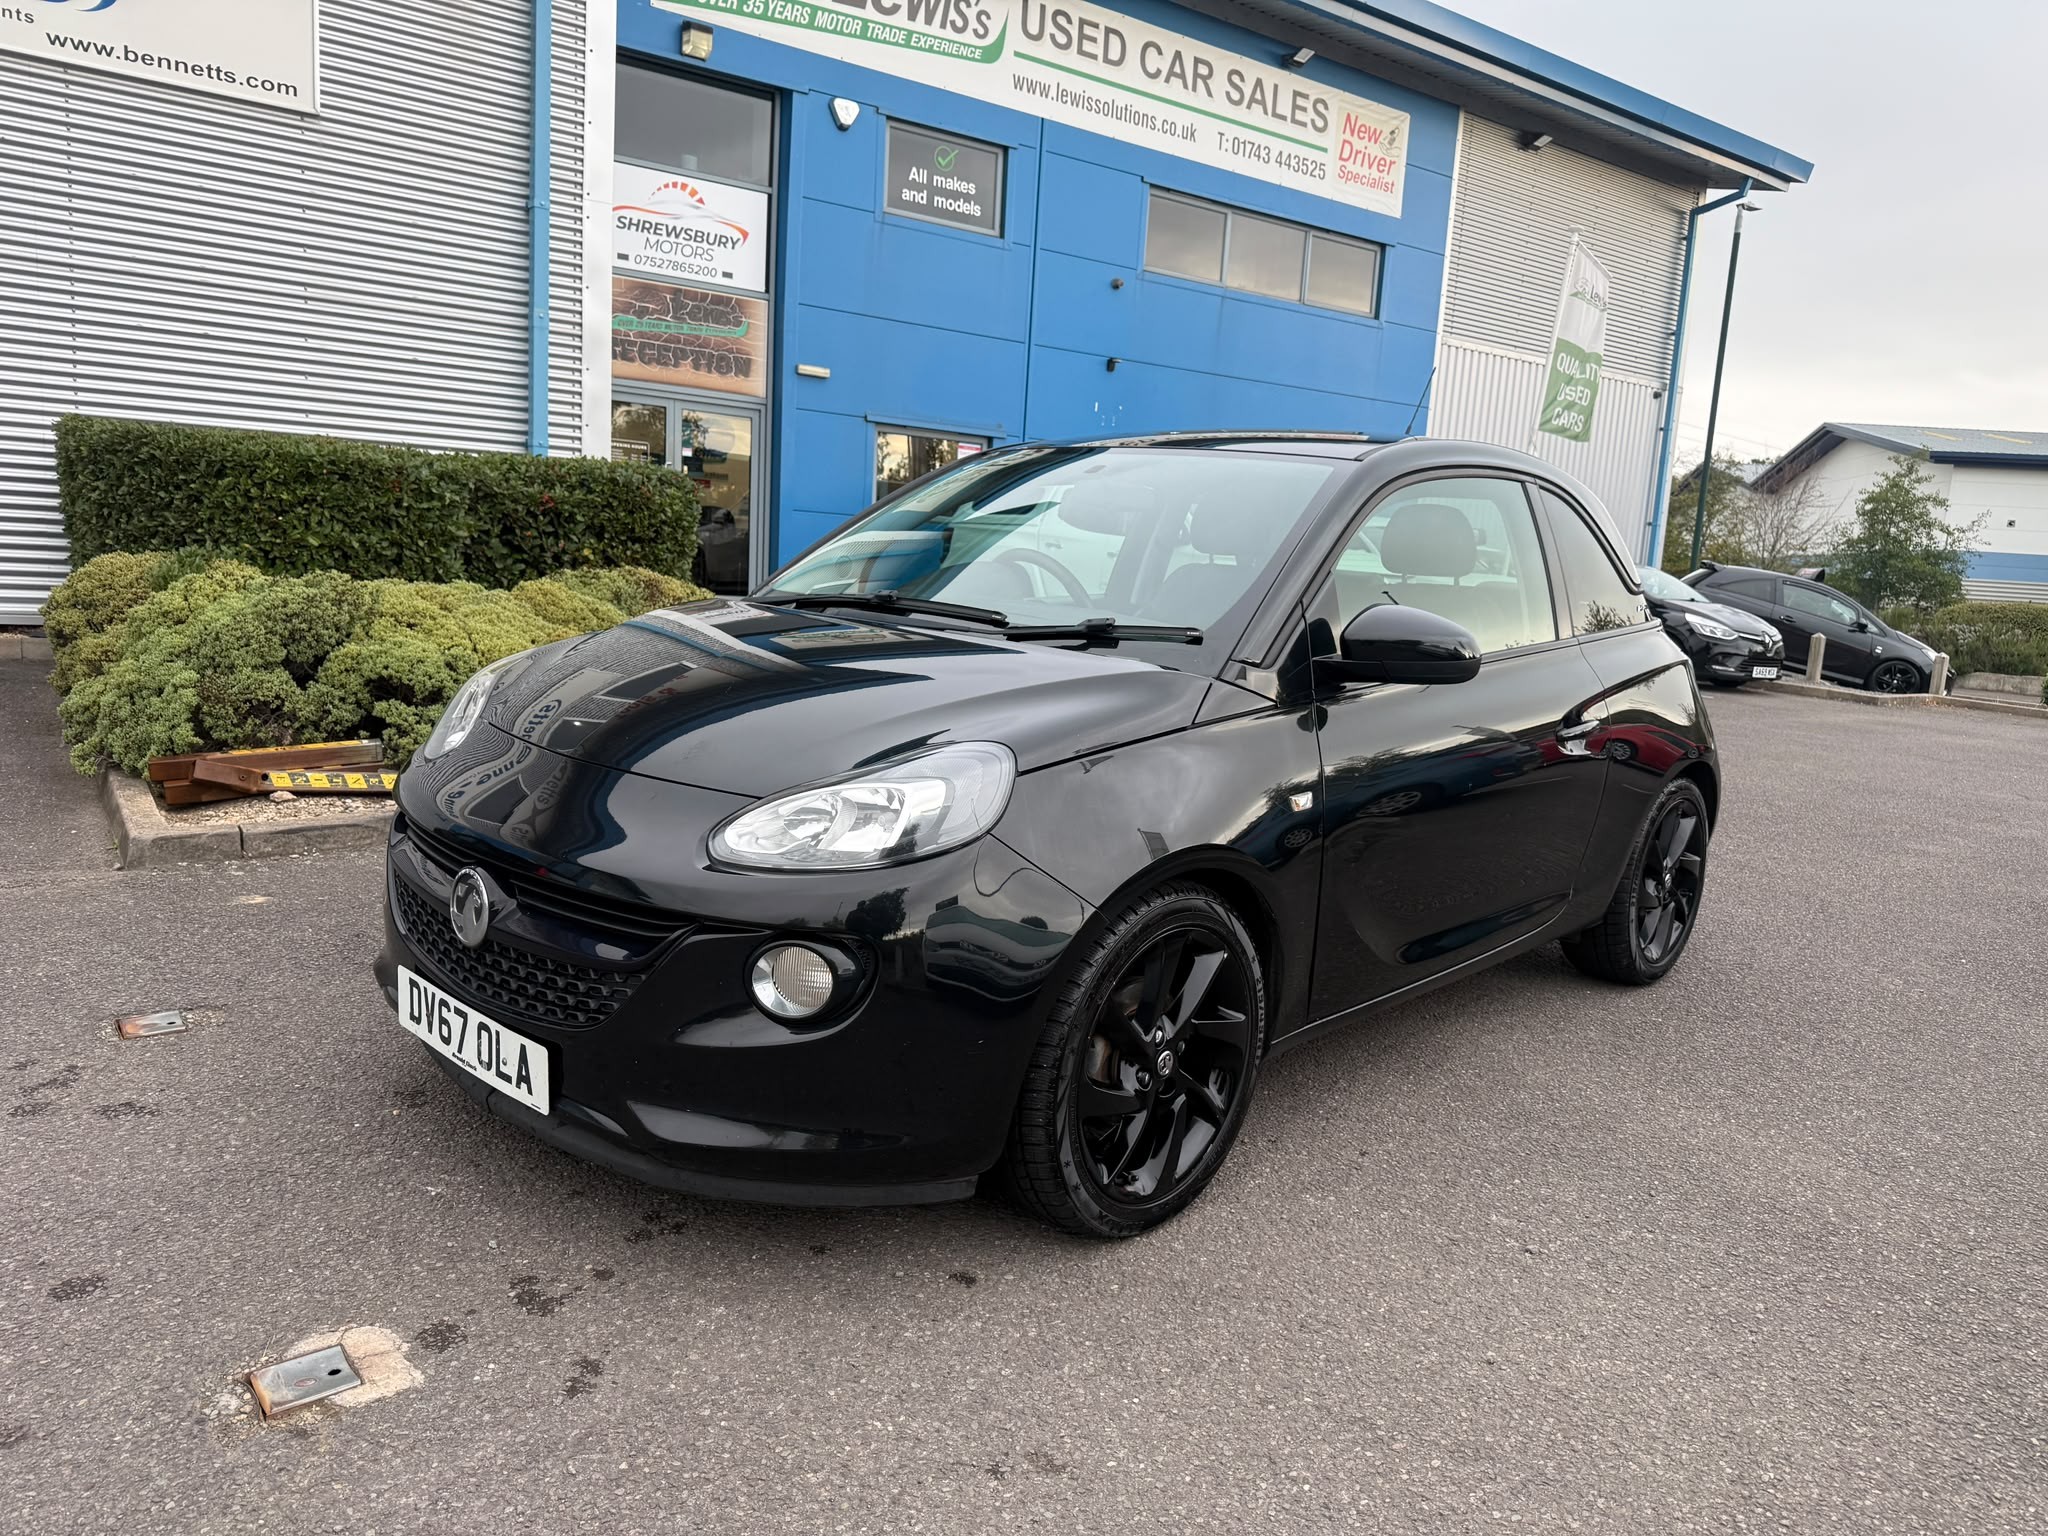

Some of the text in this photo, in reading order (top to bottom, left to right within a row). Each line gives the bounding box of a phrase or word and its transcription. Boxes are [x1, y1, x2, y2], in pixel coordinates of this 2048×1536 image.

[743, 0, 765, 15] 35
[767, 0, 811, 24] YEARS
[814, 10, 862, 35] MOTOR
[867, 22, 907, 44] TRADE
[911, 33, 983, 60] EXPERIENCE
[46, 32, 299, 97] www.bennetts.com
[1021, 0, 1329, 133] USED CAR SALES
[1012, 74, 1326, 180] www.lewissolutions.co.uk T: 01743 443525
[1343, 112, 1383, 145] New
[1338, 139, 1397, 176] Driver
[908, 166, 976, 195] All makes
[1337, 164, 1395, 194] Specialist
[902, 188, 981, 217] and models
[615, 215, 741, 250] SHREWSBURY
[634, 254, 718, 278] 07527865200
[644, 237, 715, 262] MOTORS
[1556, 383, 1591, 407] USED
[1552, 407, 1585, 433] CARS
[408, 976, 533, 1097] DV67 OLA
